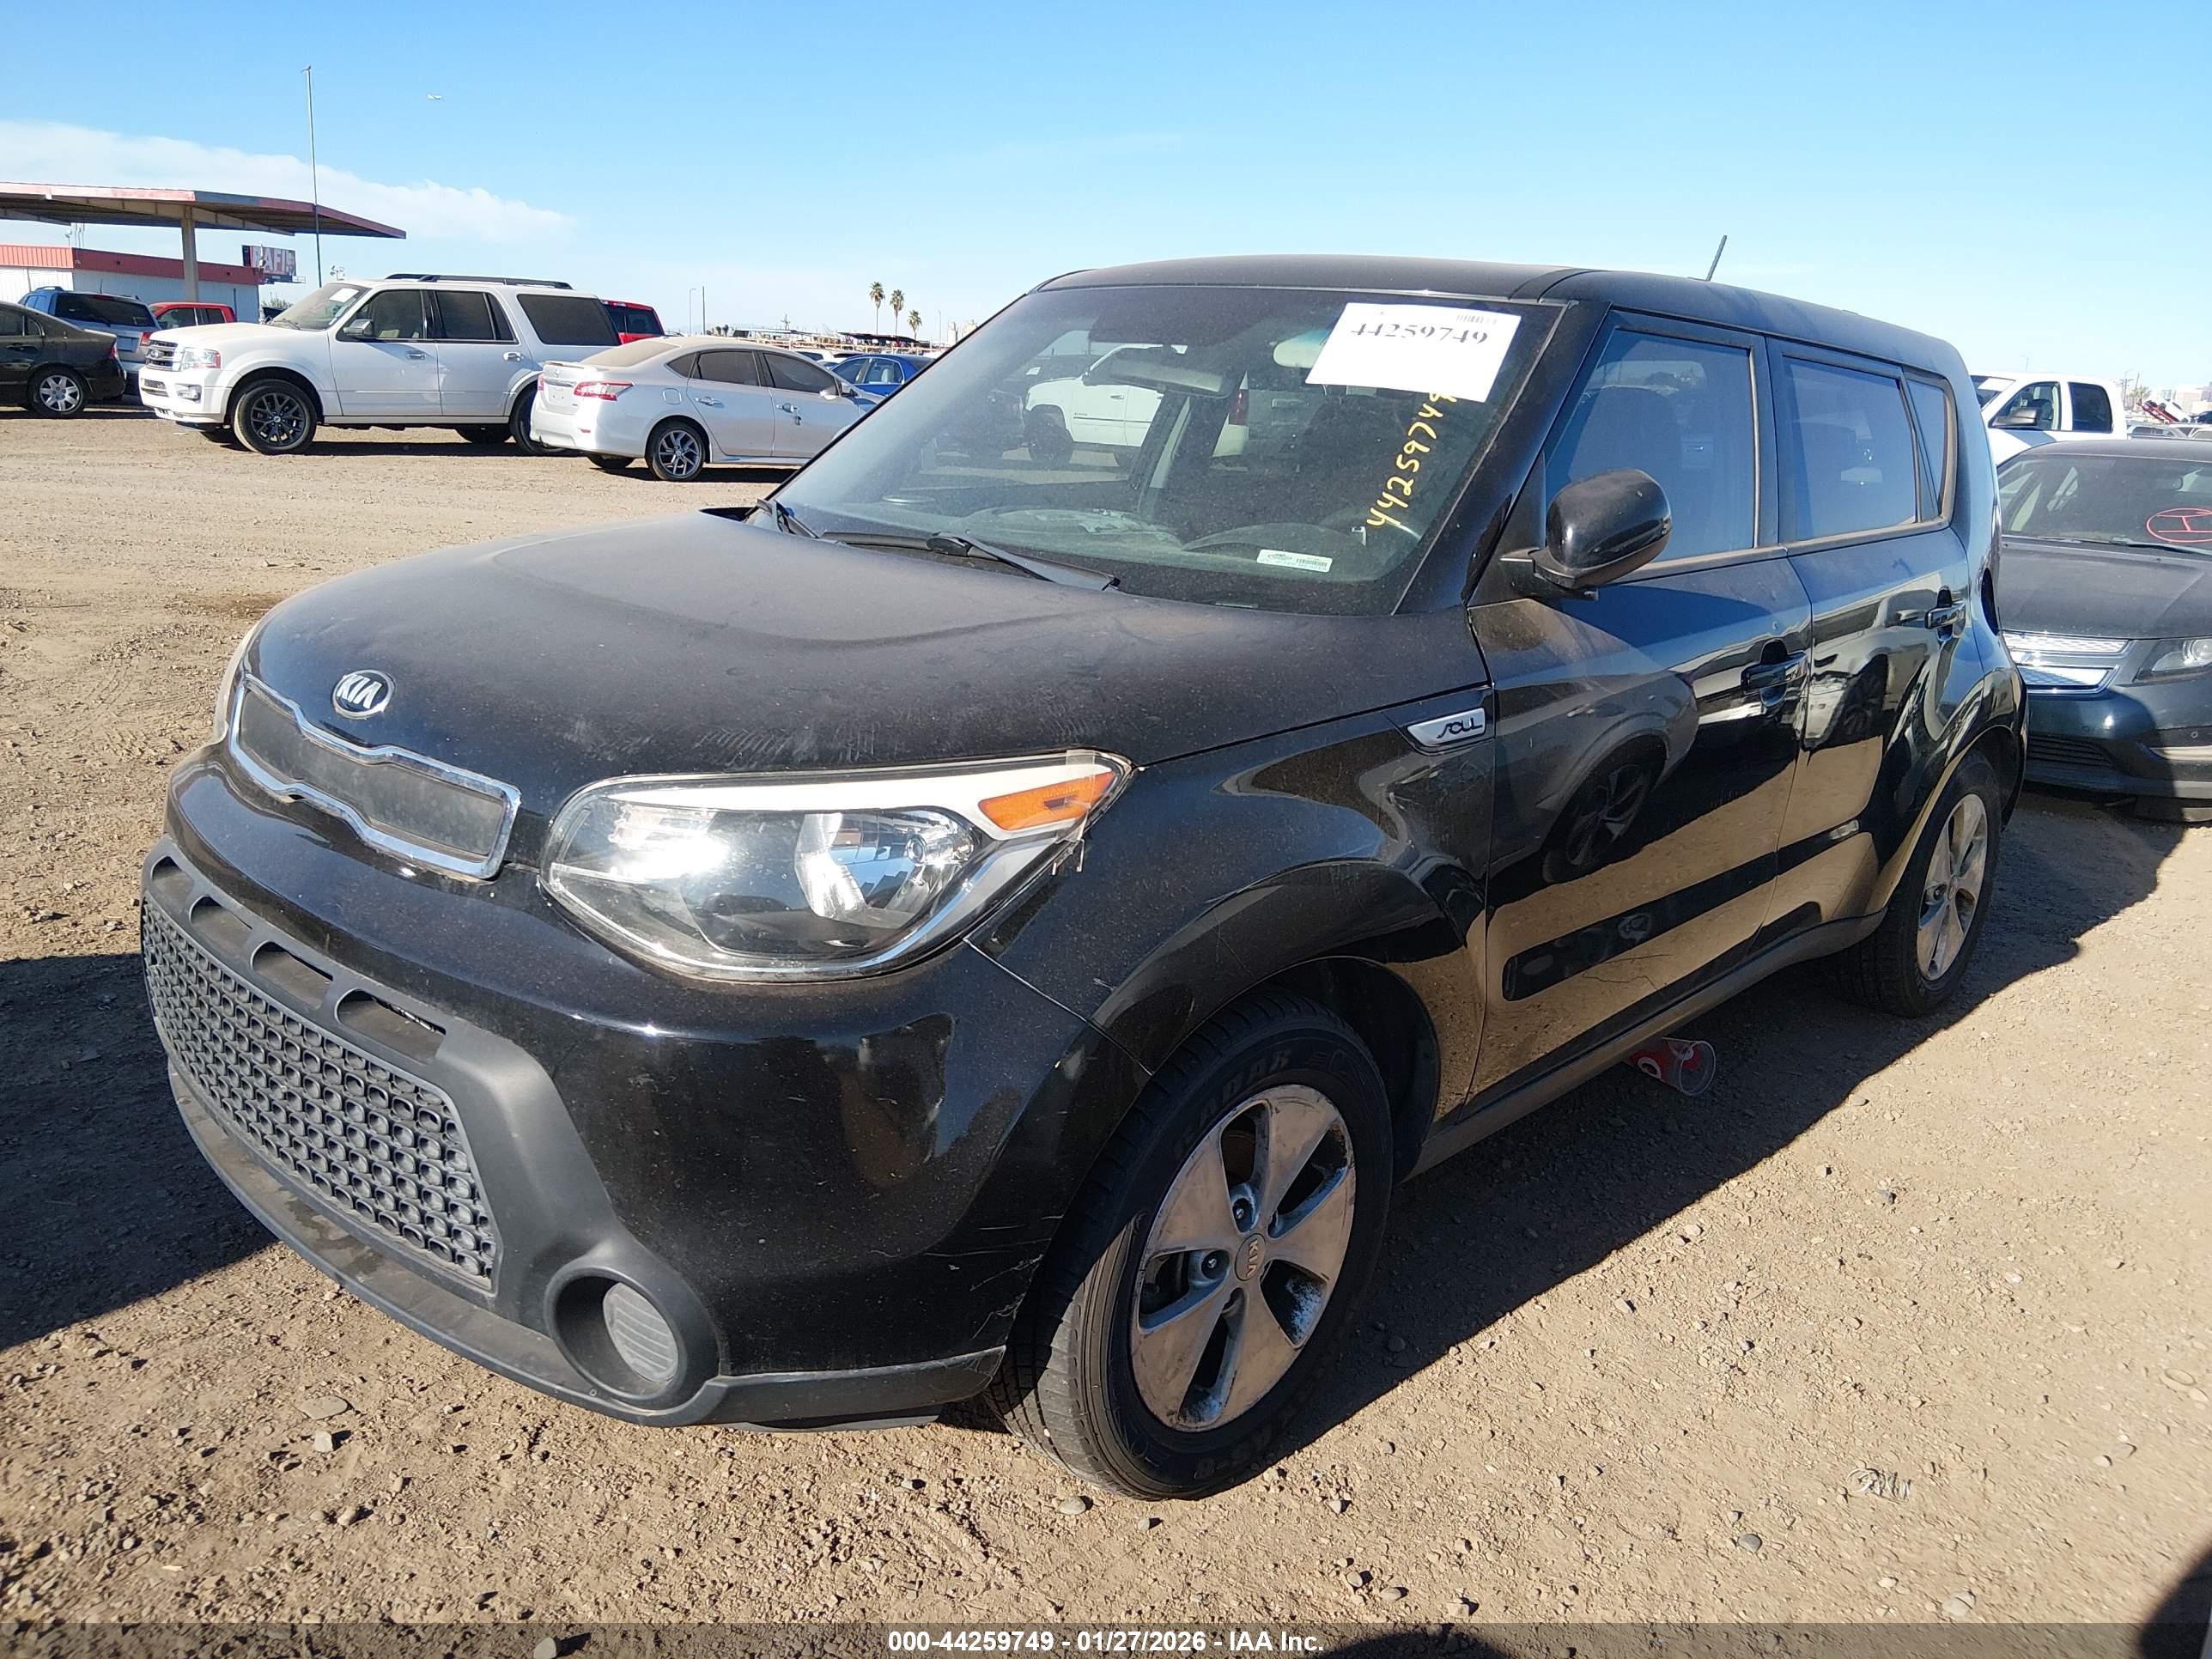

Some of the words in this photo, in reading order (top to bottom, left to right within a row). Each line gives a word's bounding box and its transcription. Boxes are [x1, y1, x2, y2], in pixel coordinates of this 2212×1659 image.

[1351, 323, 1488, 344] 44259749
[336, 674, 383, 709] KIA
[1246, 1238, 1260, 1277] KIA
